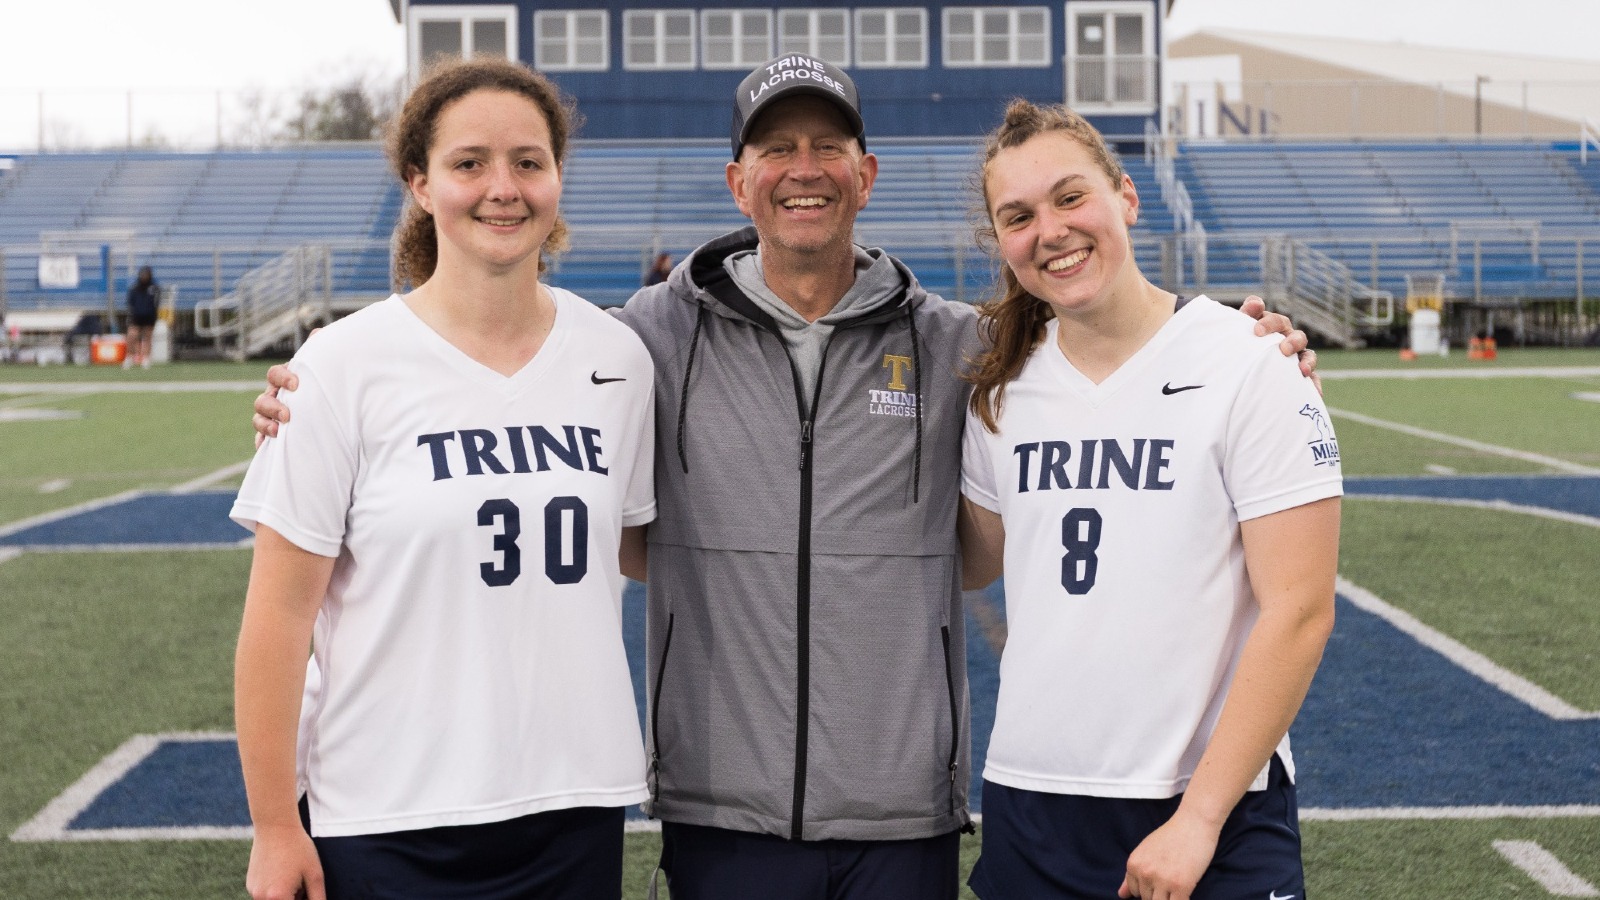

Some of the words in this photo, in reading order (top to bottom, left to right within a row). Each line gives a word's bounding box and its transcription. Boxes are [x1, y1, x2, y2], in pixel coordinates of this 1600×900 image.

[750, 68, 846, 103] LACROSSE
[766, 55, 826, 75] TRINE
[882, 354, 912, 390] T
[416, 424, 609, 482] TRINE
[1013, 438, 1175, 493] TRINE
[477, 495, 588, 587] 30
[1061, 507, 1103, 595] 8
